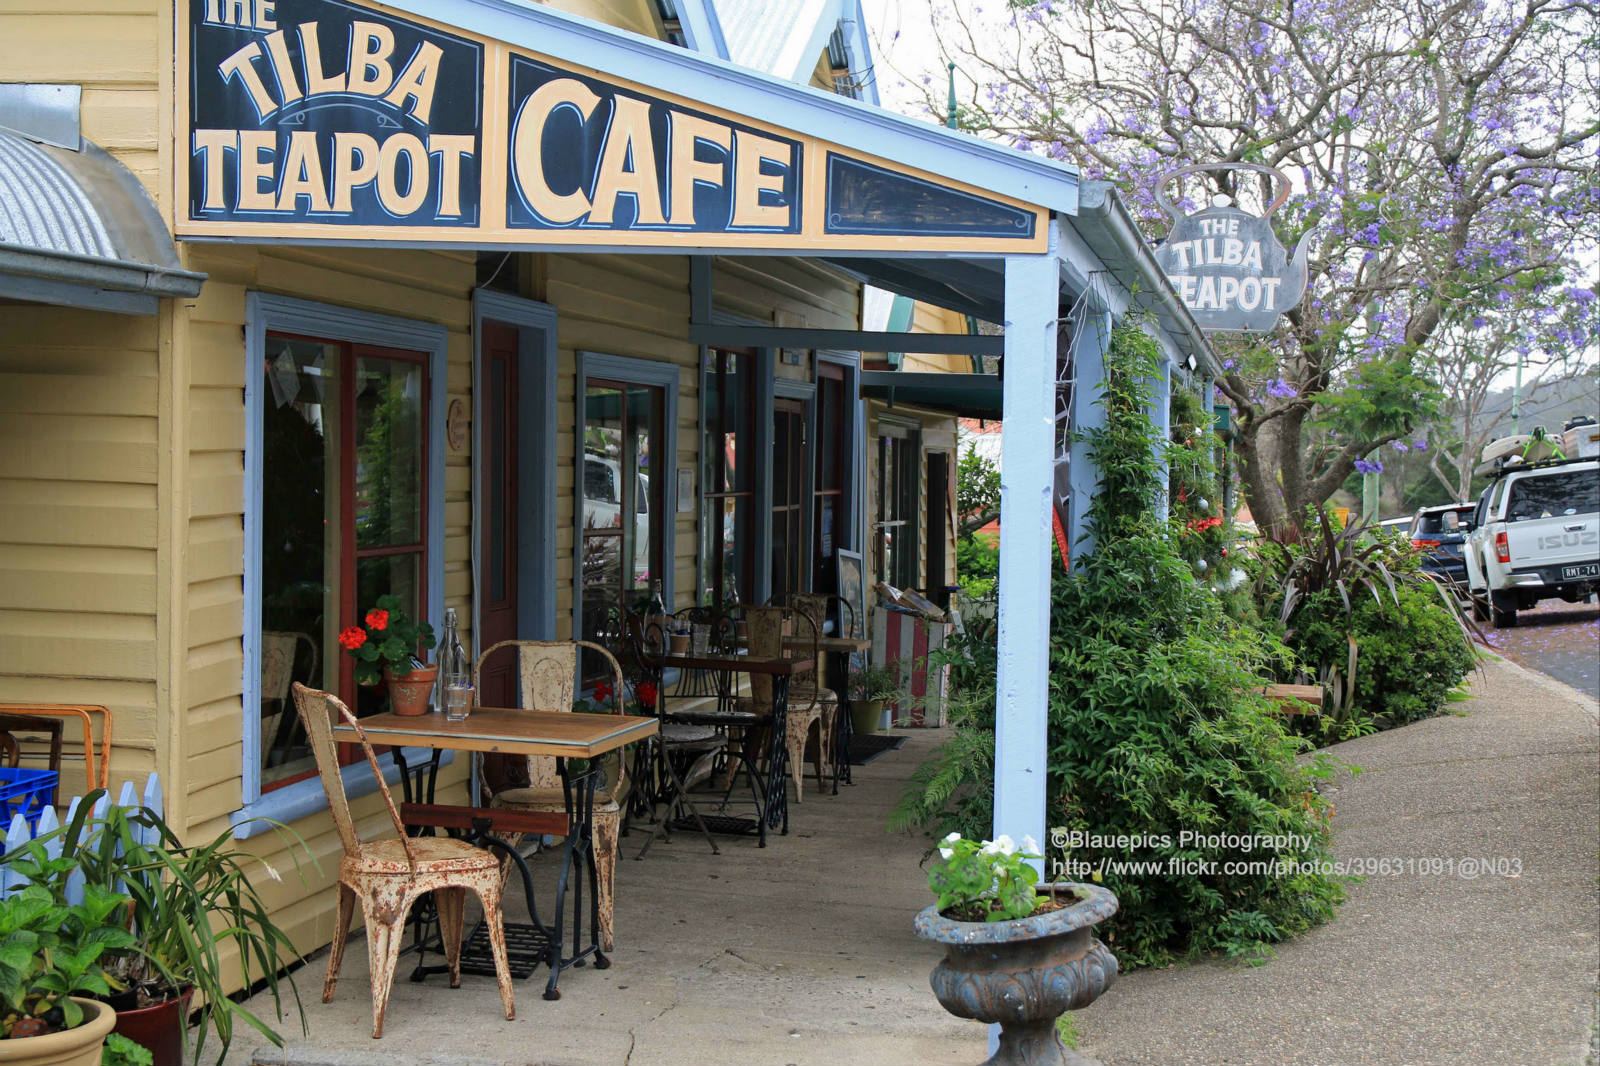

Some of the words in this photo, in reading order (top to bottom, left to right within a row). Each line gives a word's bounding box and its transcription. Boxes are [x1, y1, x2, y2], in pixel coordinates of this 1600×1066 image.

[218, 20, 444, 125] TILBA
[193, 129, 475, 219] TEAPOT
[512, 78, 791, 229] CAFE
[1171, 237, 1263, 271] TILBA
[1199, 218, 1240, 236] THE
